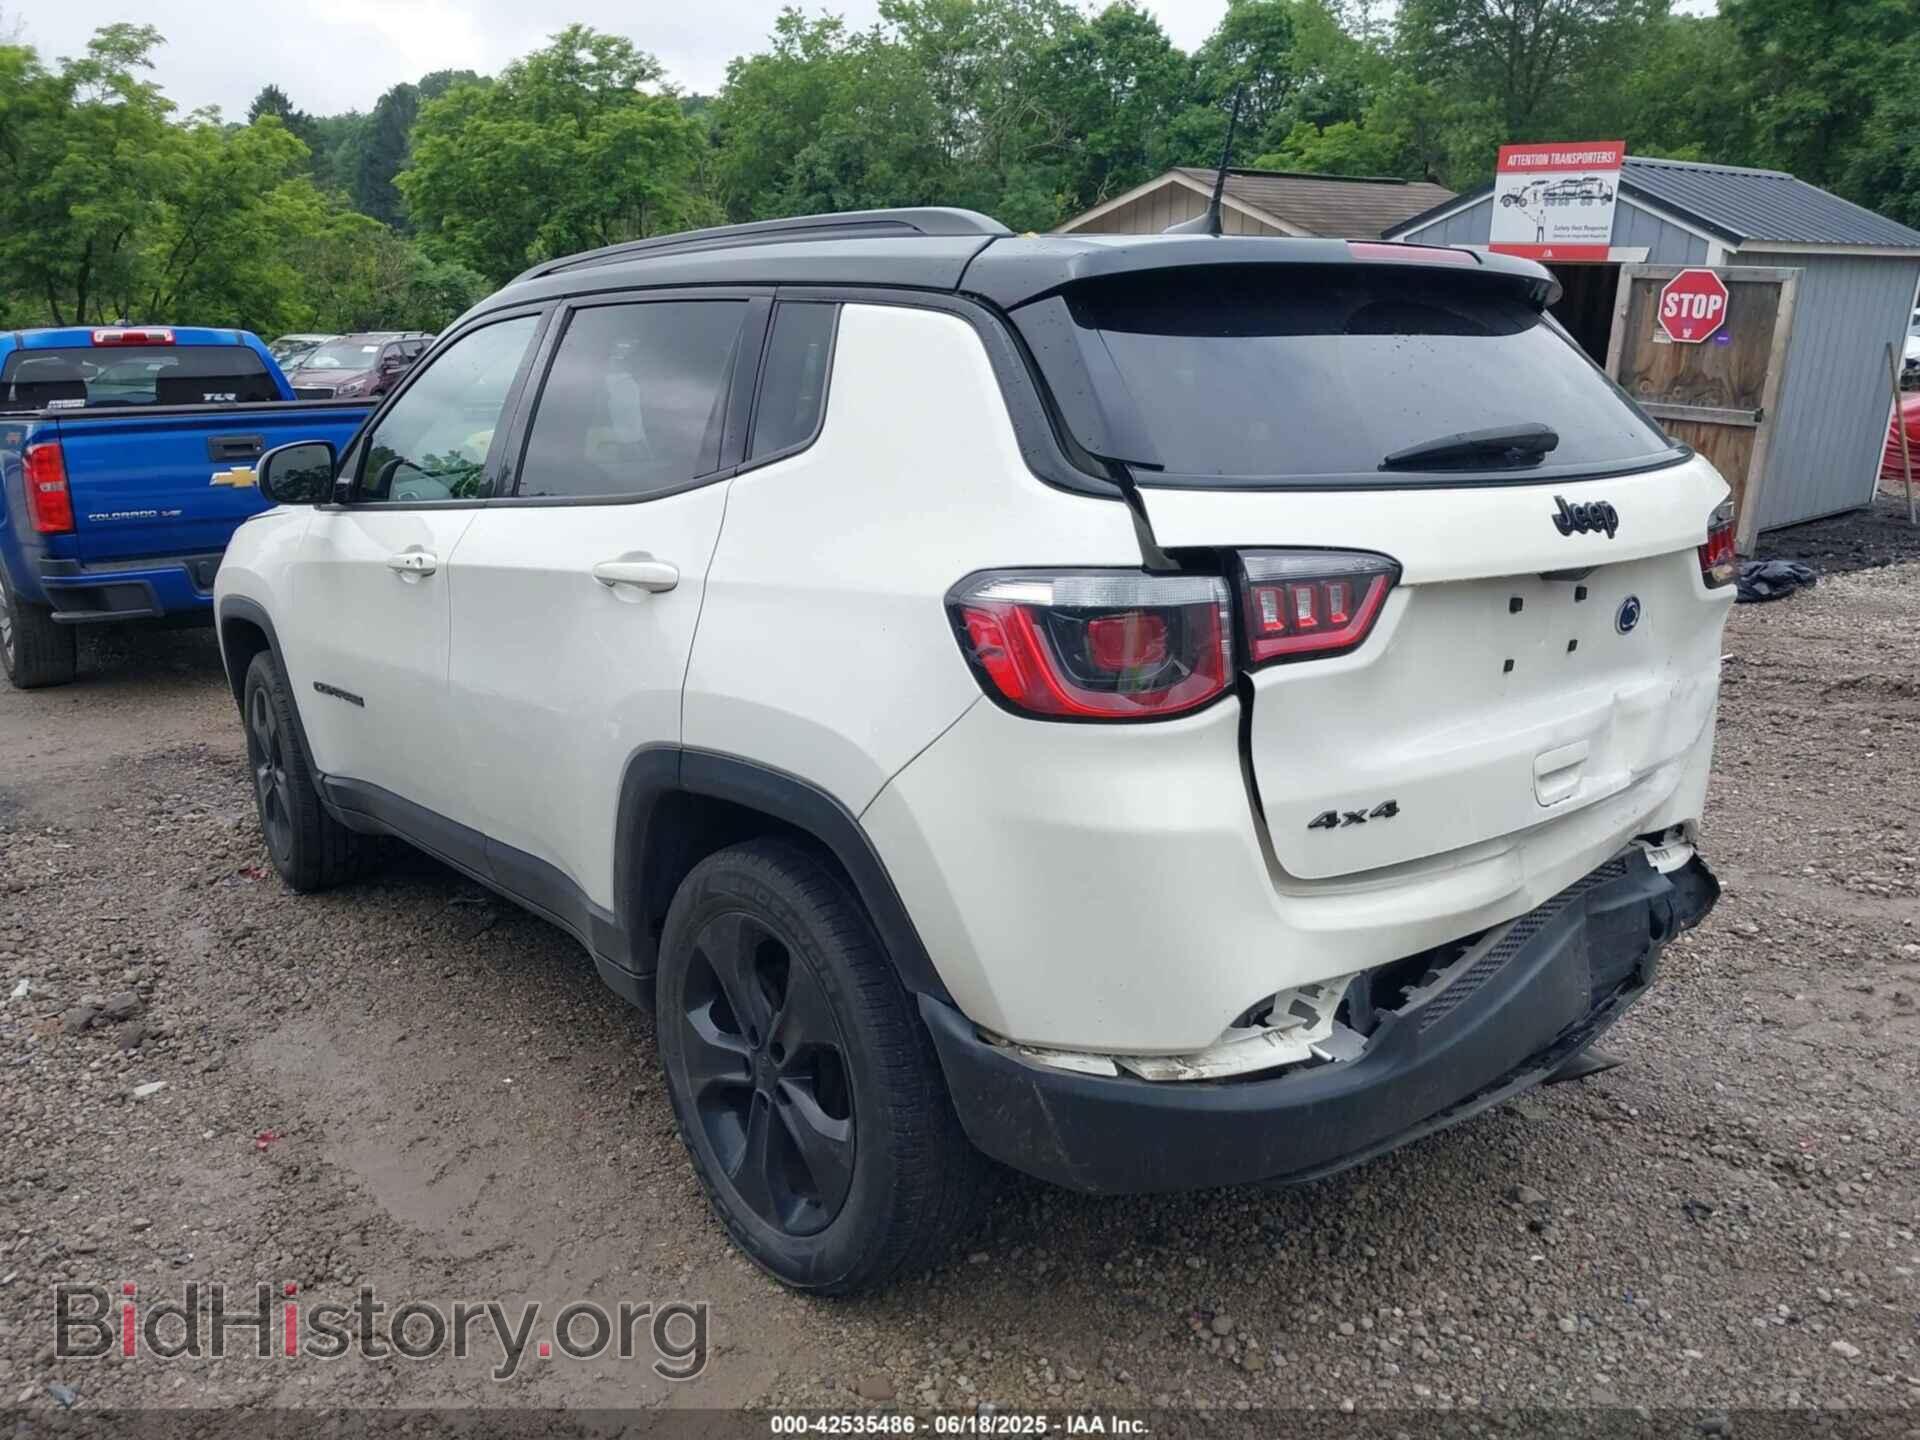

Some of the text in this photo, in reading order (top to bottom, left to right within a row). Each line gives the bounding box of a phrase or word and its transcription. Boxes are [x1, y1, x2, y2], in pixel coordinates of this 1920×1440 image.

[1507, 153, 1549, 167] ATTENTION
[1663, 292, 1723, 319] STOP
[1552, 495, 1619, 540] Jeep
[1308, 799, 1400, 829] 4x4
